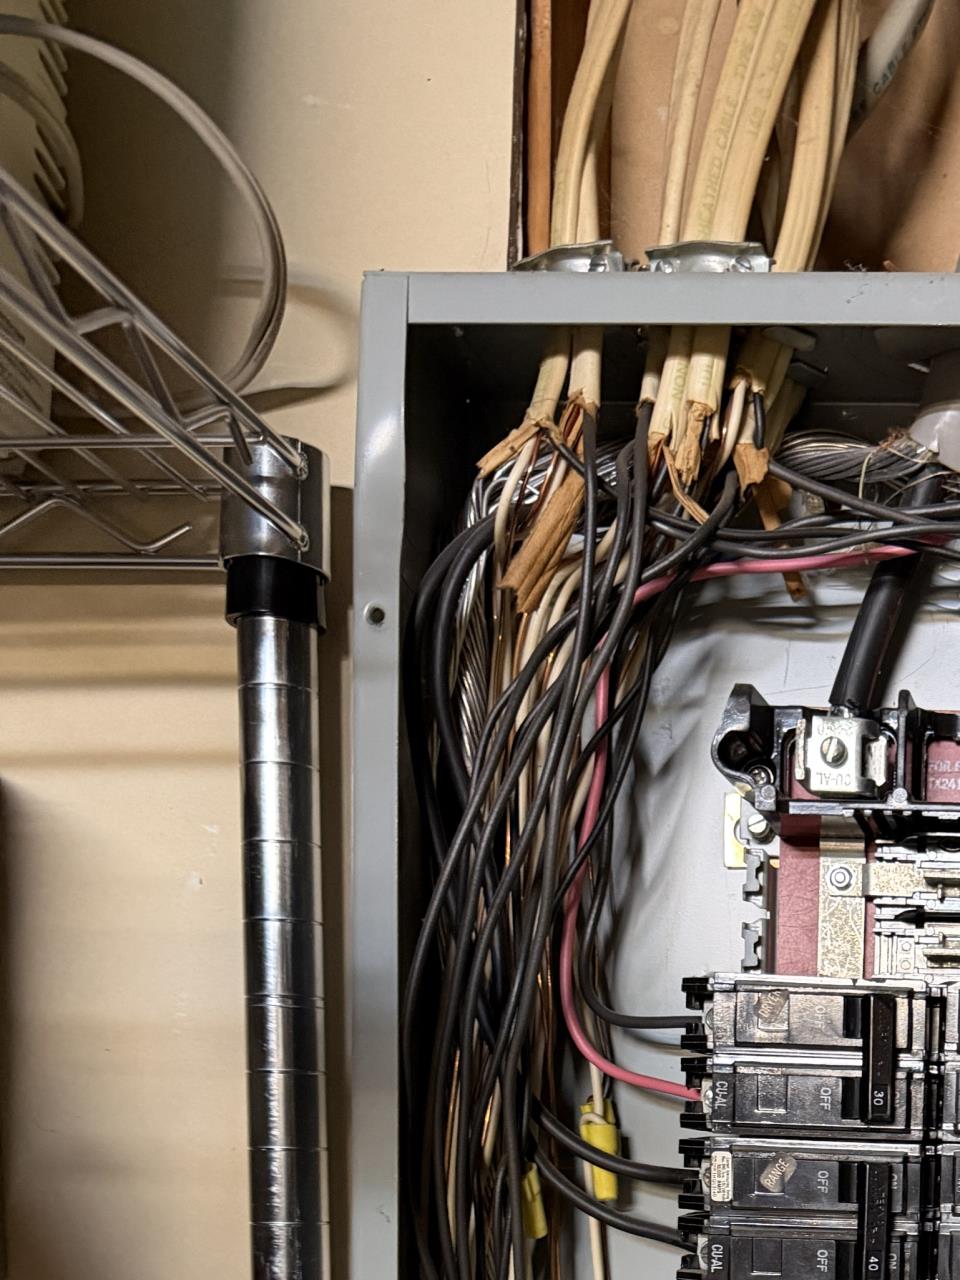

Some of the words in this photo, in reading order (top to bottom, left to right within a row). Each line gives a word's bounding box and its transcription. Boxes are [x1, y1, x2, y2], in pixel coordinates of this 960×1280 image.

[714, 1080, 729, 1109] CU-AL
[820, 1087, 832, 1111] OFF
[873, 1090, 885, 1106] 30
[764, 1158, 791, 1187] RANGE
[817, 1170, 830, 1194] OFF
[710, 1244, 723, 1273] CU-AL
[816, 1250, 829, 1273] OFF
[868, 1256, 879, 1272] 40
